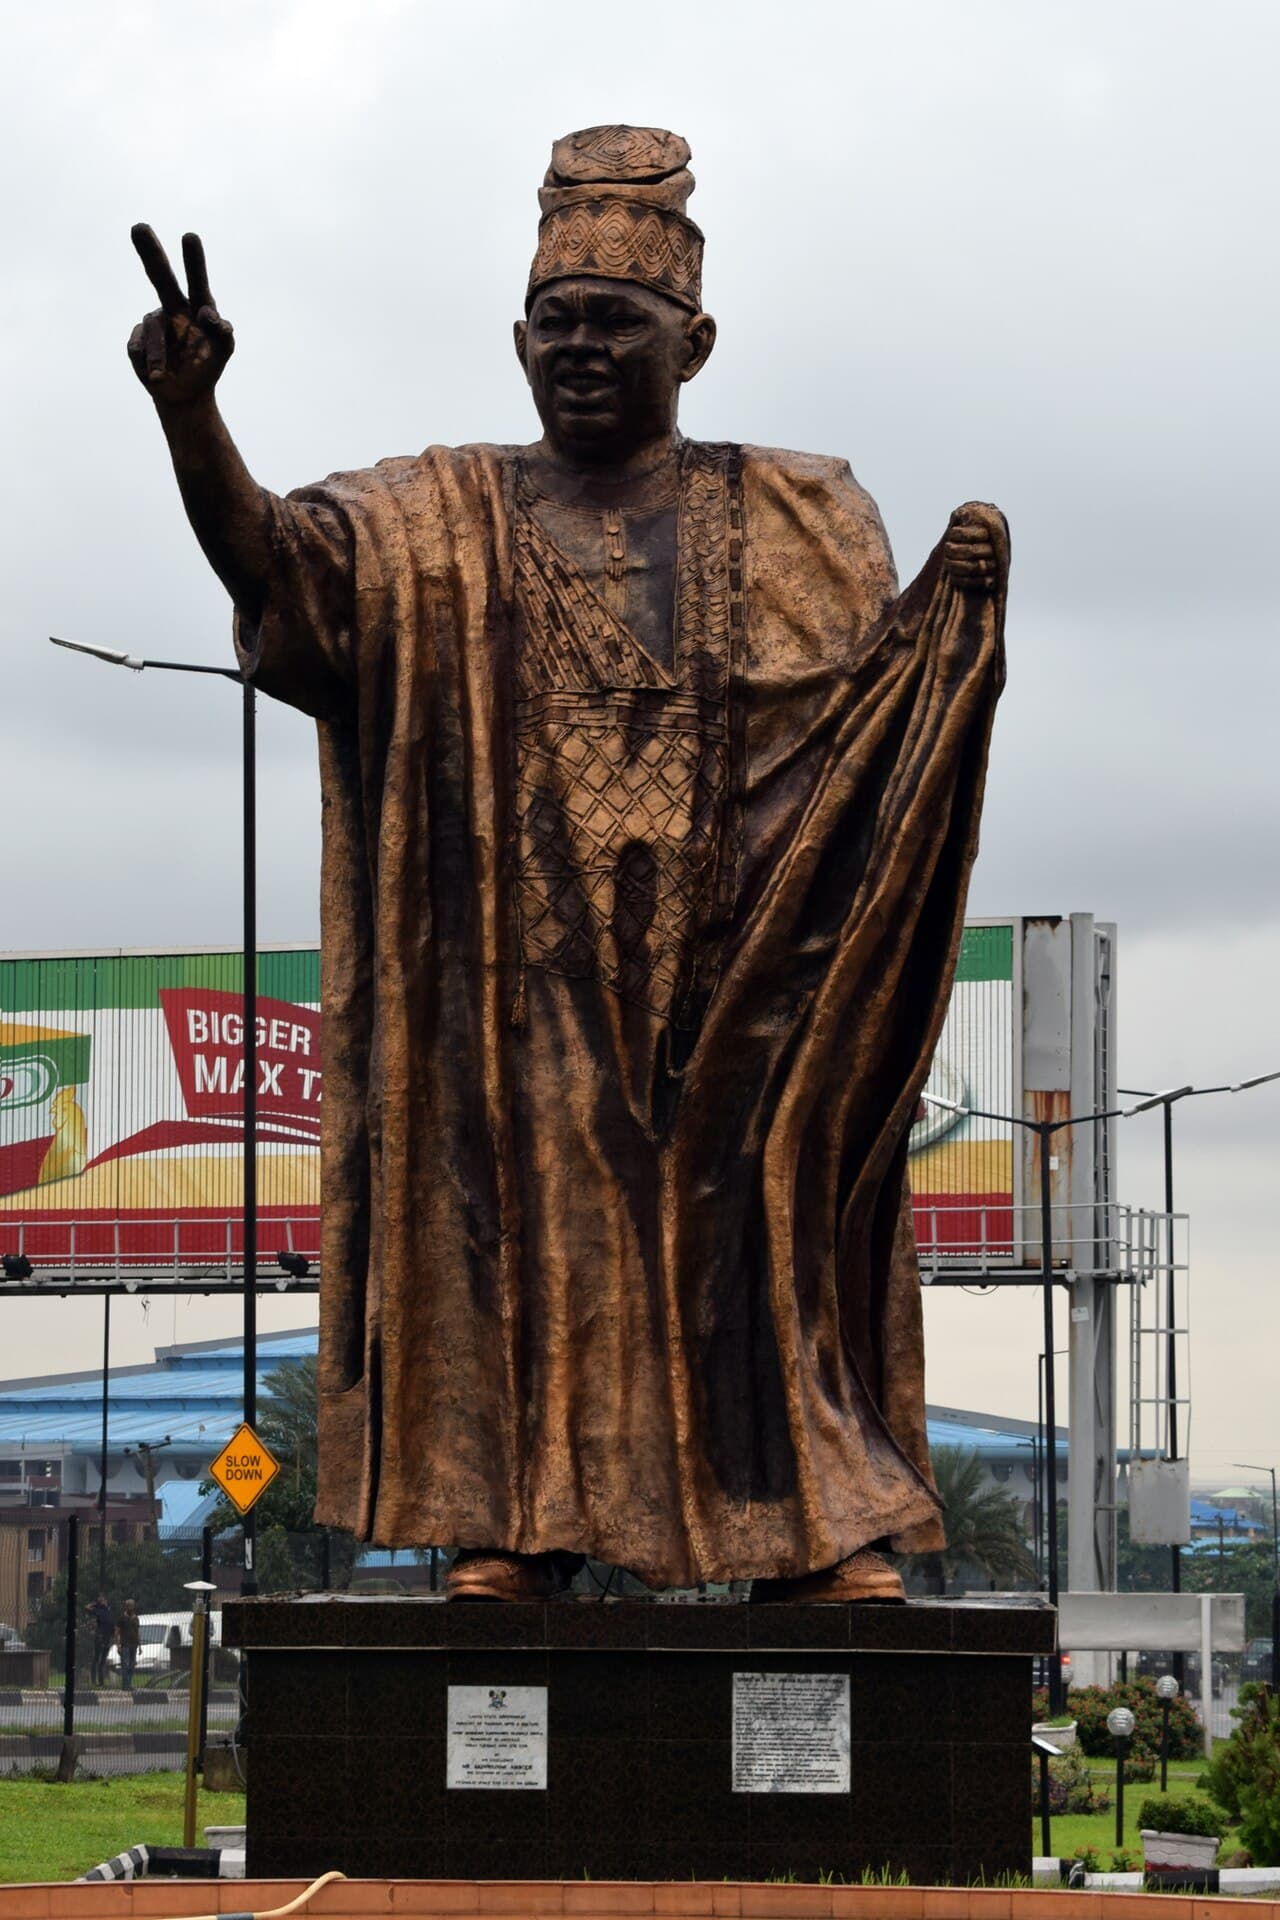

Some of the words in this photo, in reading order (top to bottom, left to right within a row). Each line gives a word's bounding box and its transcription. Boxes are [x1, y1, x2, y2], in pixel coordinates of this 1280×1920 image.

[297, 1067, 322, 1102] T
[226, 1456, 261, 1467] SLOW
[226, 1469, 263, 1480] DOWN
